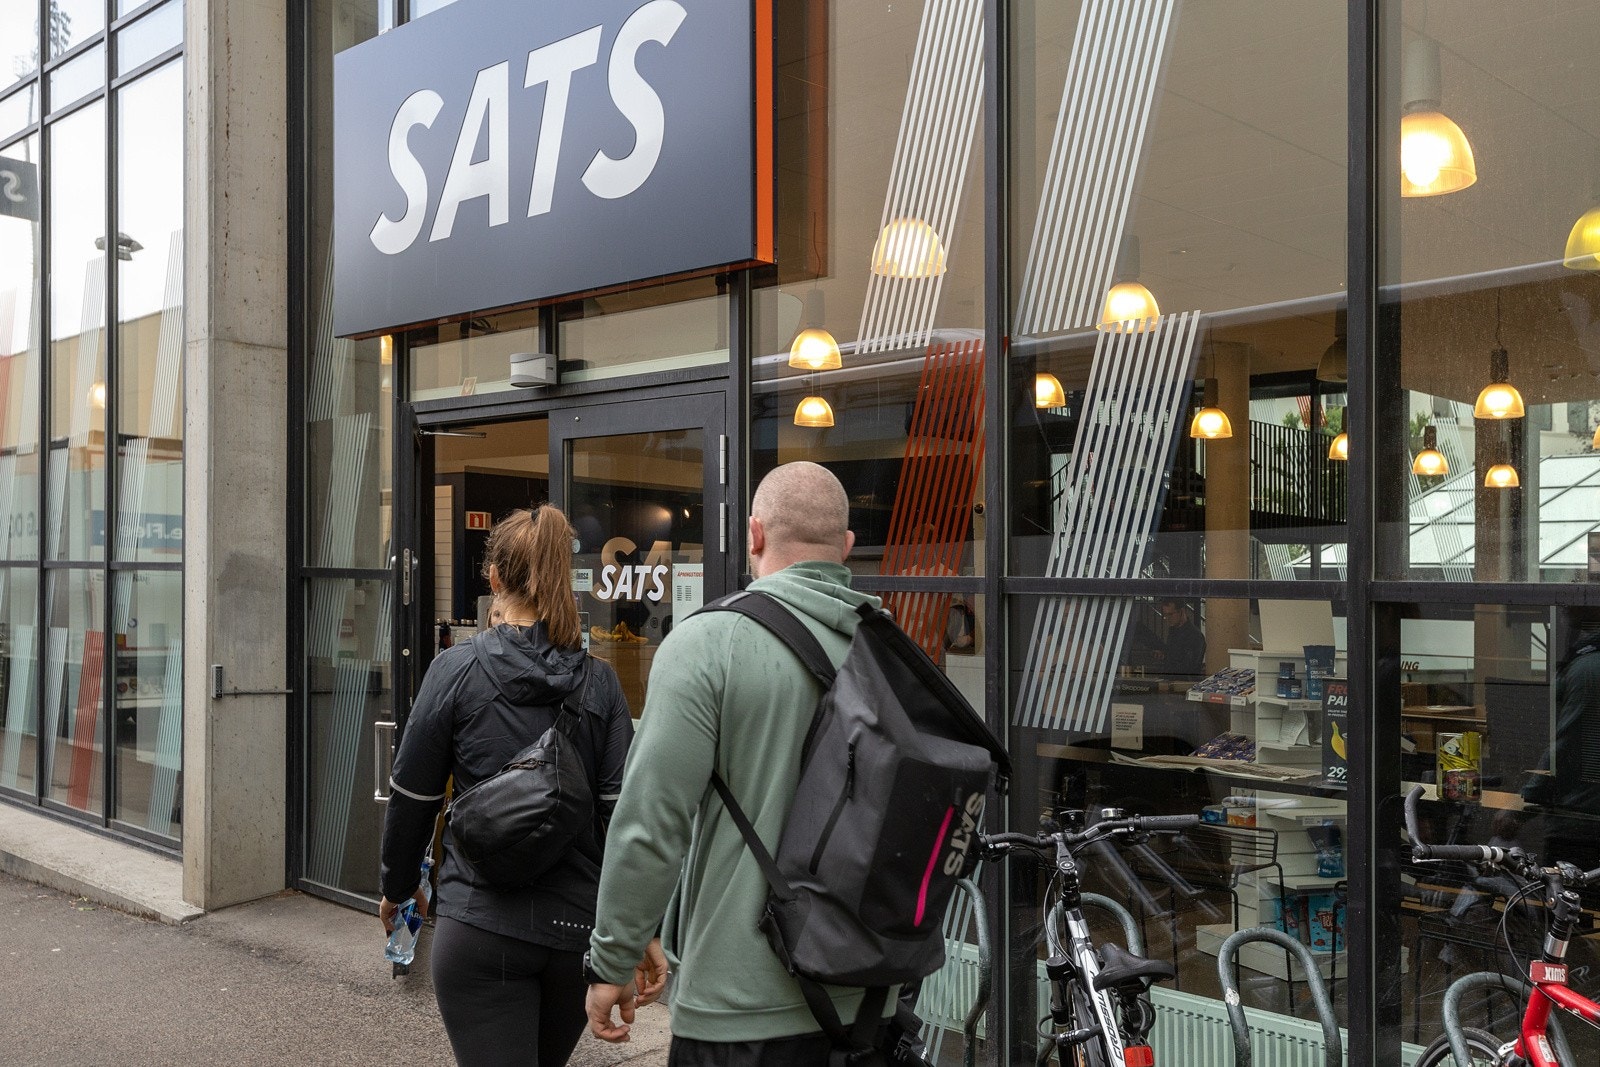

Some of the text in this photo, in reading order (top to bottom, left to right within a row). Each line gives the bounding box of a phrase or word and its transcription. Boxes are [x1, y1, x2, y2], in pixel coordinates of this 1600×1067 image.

[369, 0, 687, 255] SATS
[597, 565, 668, 601] SATS
[944, 792, 985, 876] SATS
